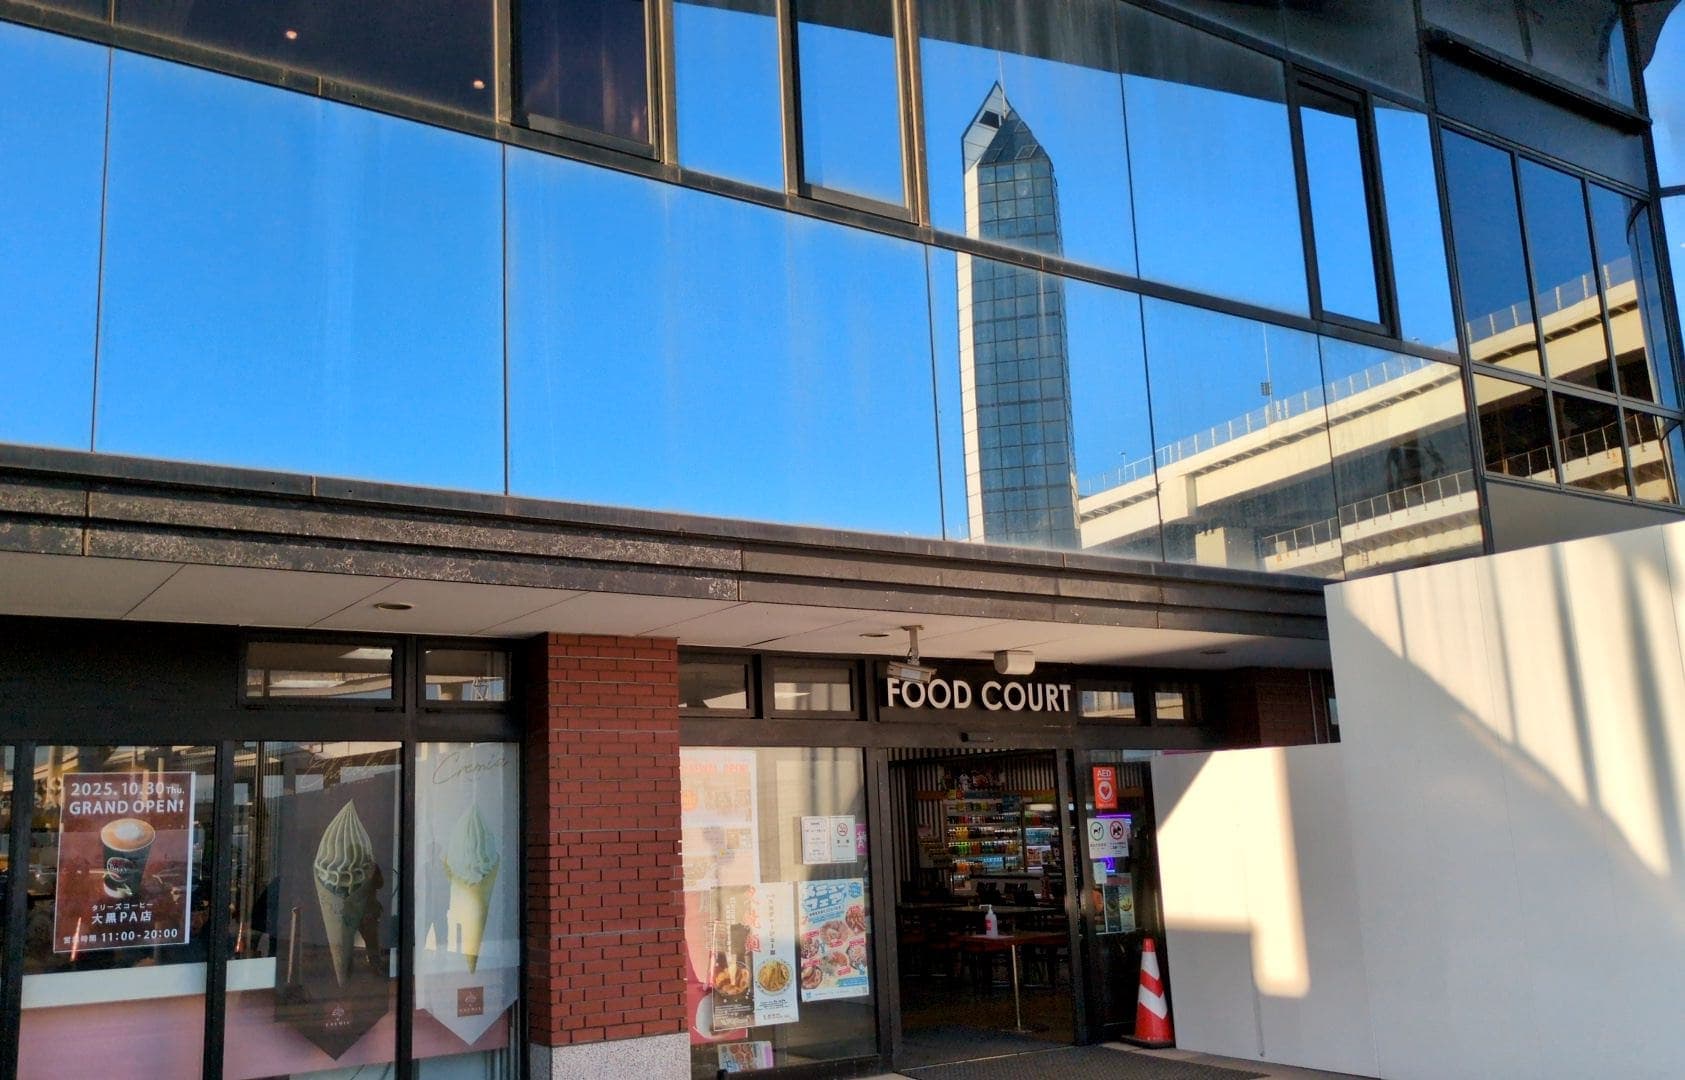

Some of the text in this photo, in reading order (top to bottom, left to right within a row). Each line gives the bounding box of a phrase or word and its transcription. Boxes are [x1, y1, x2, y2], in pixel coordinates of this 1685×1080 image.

[887, 677, 1071, 712] FOOD COURT
[1097, 769, 1112, 777] AED
[69, 799, 184, 815] GRAND OPEN!
[91, 902, 154, 912] タリーズコーヒー
[91, 910, 153, 925] 大黒PA店
[63, 934, 97, 945] 営時間
